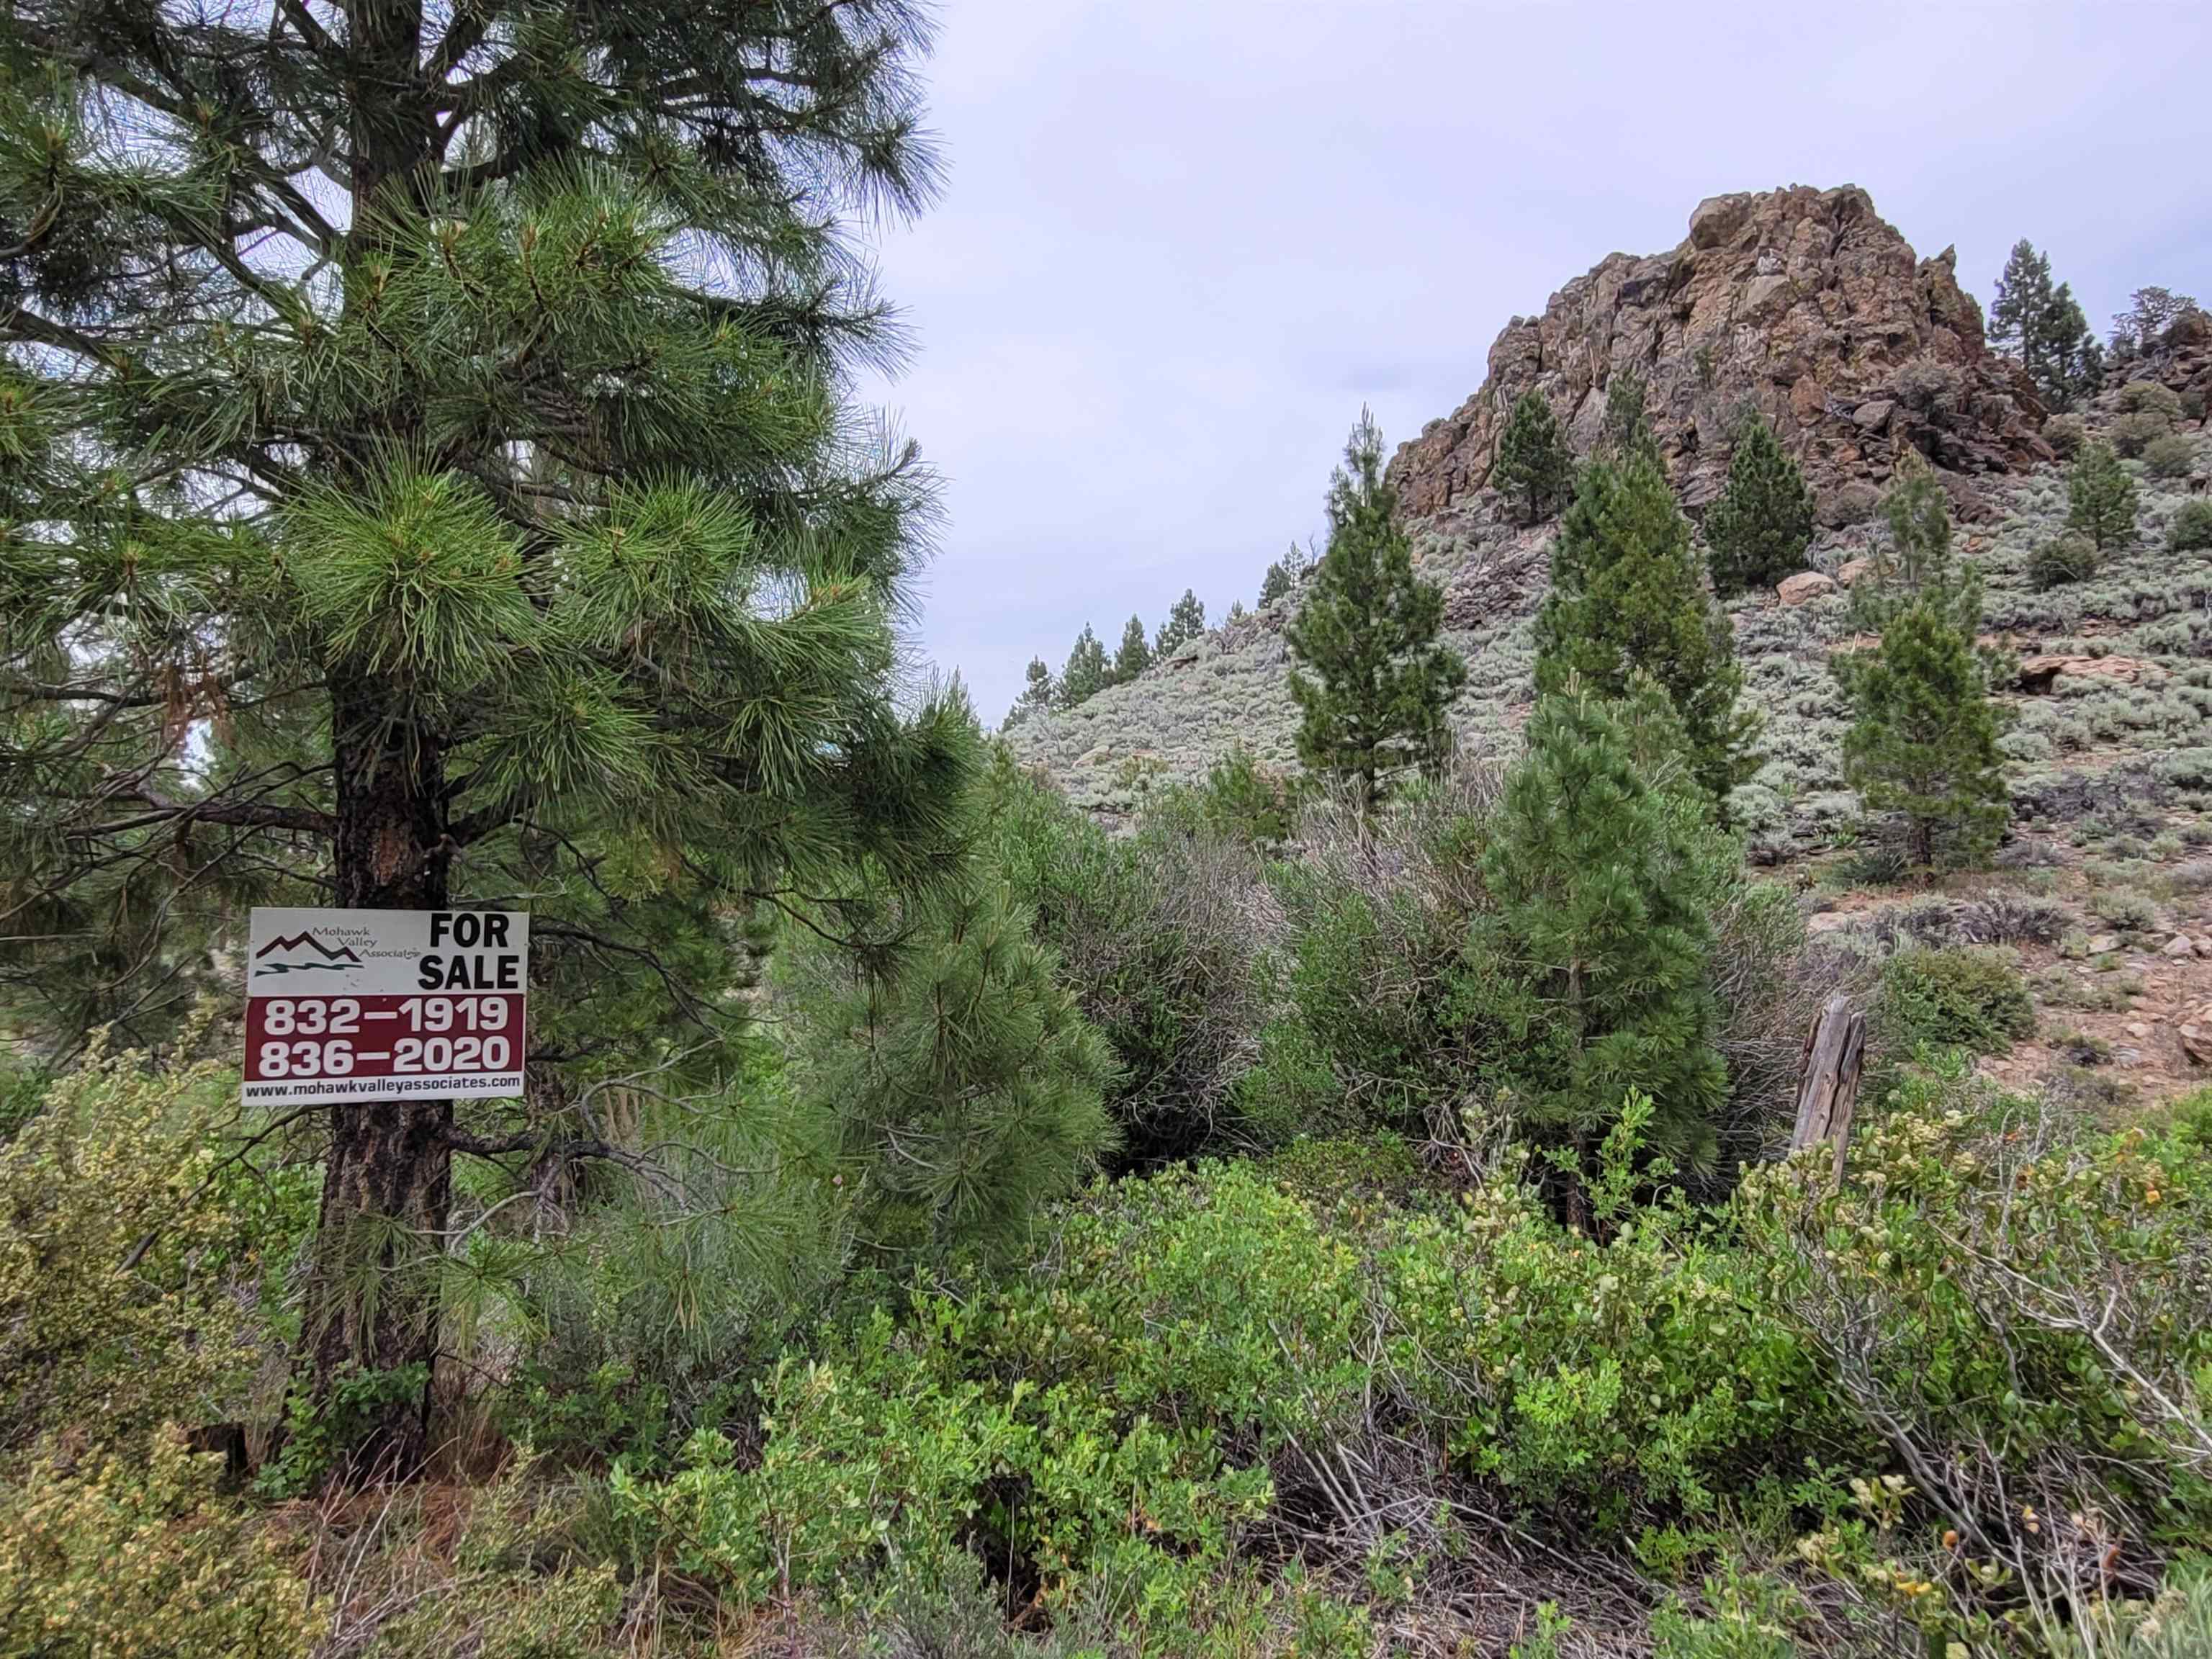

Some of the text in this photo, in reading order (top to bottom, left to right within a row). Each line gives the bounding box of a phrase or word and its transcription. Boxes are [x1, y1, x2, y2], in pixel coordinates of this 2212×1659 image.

[312, 926, 370, 936] Mohawk
[338, 938, 378, 948] Valley
[430, 913, 509, 948] FOR
[418, 955, 519, 990] SALE
[264, 997, 508, 1035] 832-1919
[258, 1035, 511, 1077] 836-2020
[246, 1076, 521, 1097] www.mohawkvalleyassociates.com
